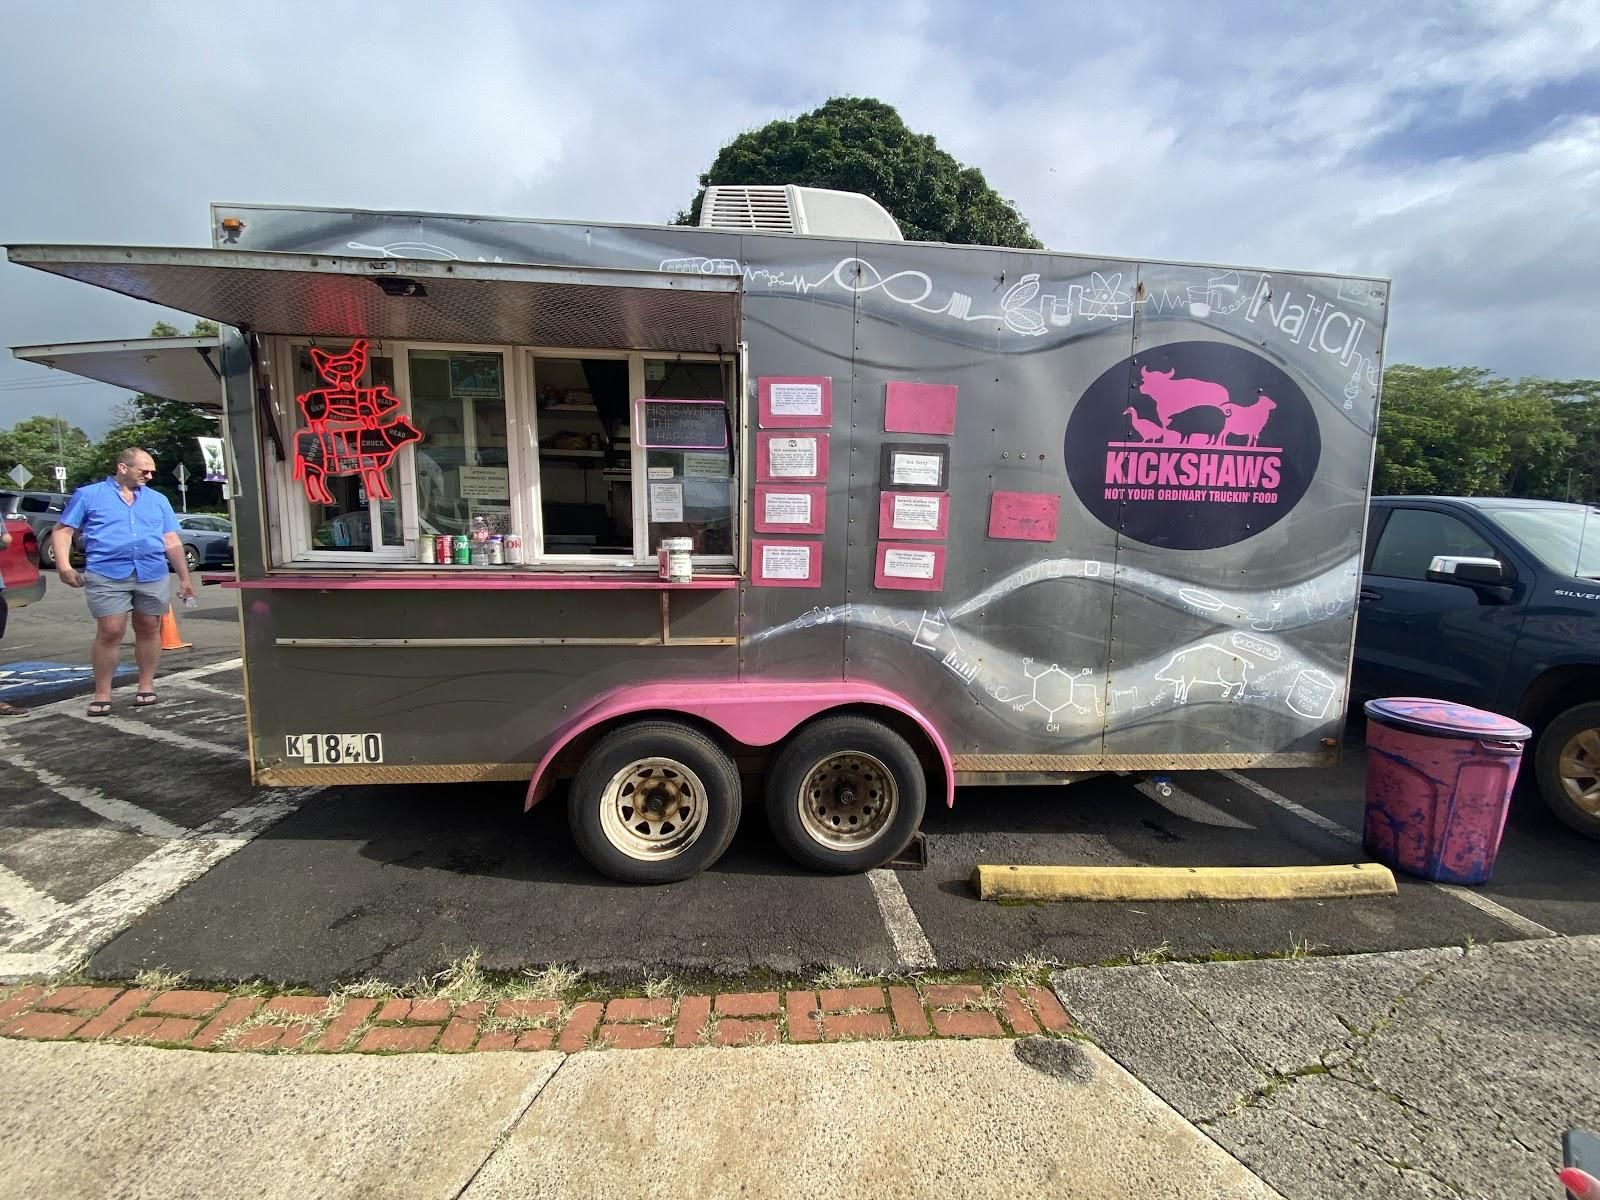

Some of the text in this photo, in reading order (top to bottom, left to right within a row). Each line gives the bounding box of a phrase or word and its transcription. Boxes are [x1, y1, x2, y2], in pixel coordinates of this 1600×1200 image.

[388, 428, 407, 440] HEAD
[361, 438, 385, 447] CHUCK
[1105, 451, 1281, 489] KICKSHAWS
[1104, 488, 1278, 504] NOT YOUR ORDINARY TRUCKIN' FOOD
[1022, 657, 1034, 665] OH
[1081, 668, 1093, 676] OH
[1012, 703, 1025, 712] HO
[1078, 706, 1091, 715] OH
[1046, 723, 1060, 733] OH
